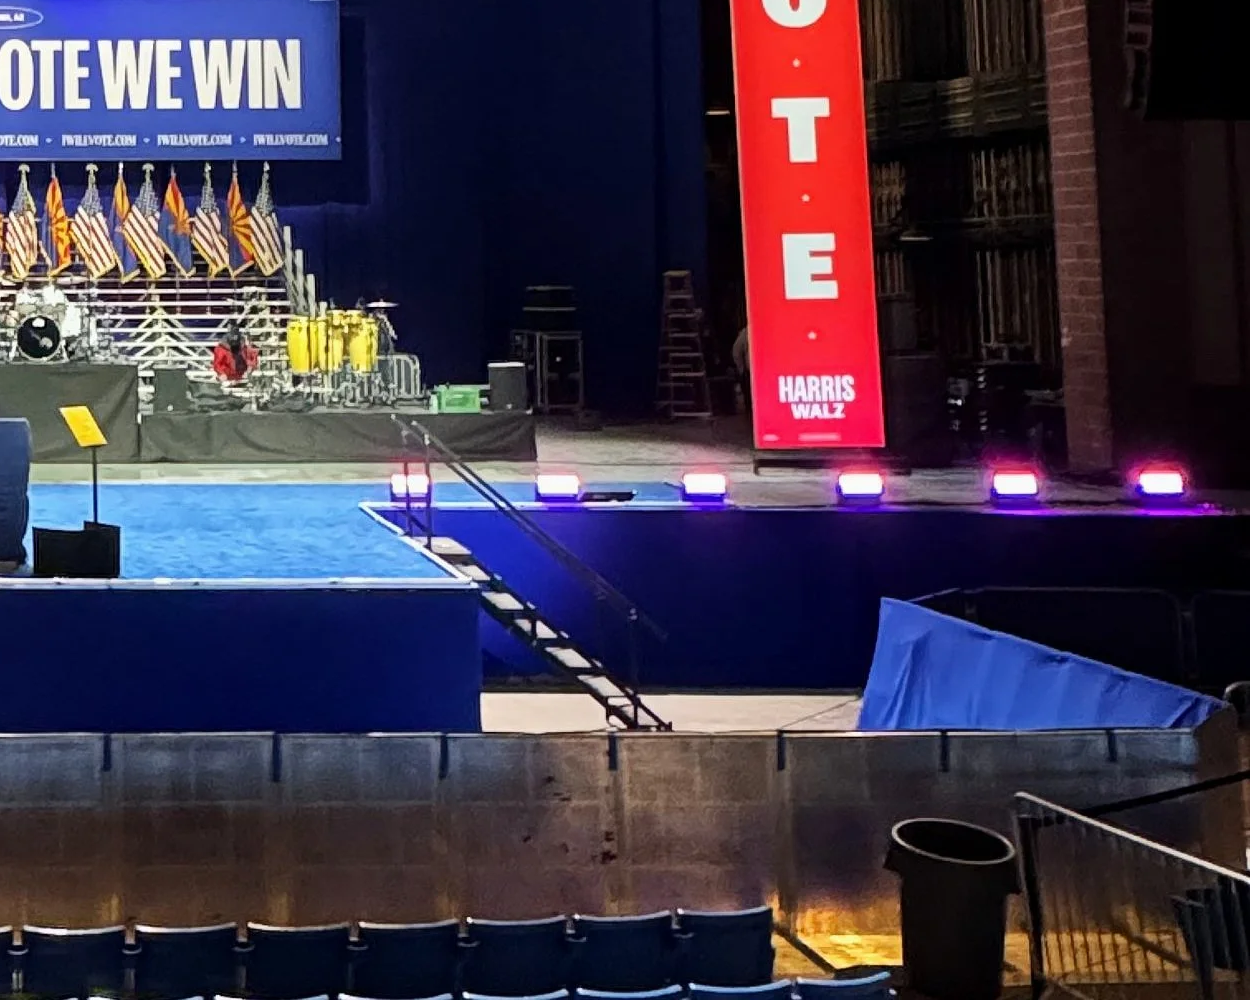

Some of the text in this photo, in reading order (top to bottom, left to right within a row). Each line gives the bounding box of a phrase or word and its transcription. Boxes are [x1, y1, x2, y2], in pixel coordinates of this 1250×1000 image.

[97, 39, 183, 110] WE
[188, 38, 302, 110] WIN
[777, 374, 856, 403] HARRIS
[790, 402, 846, 420] WALZ
